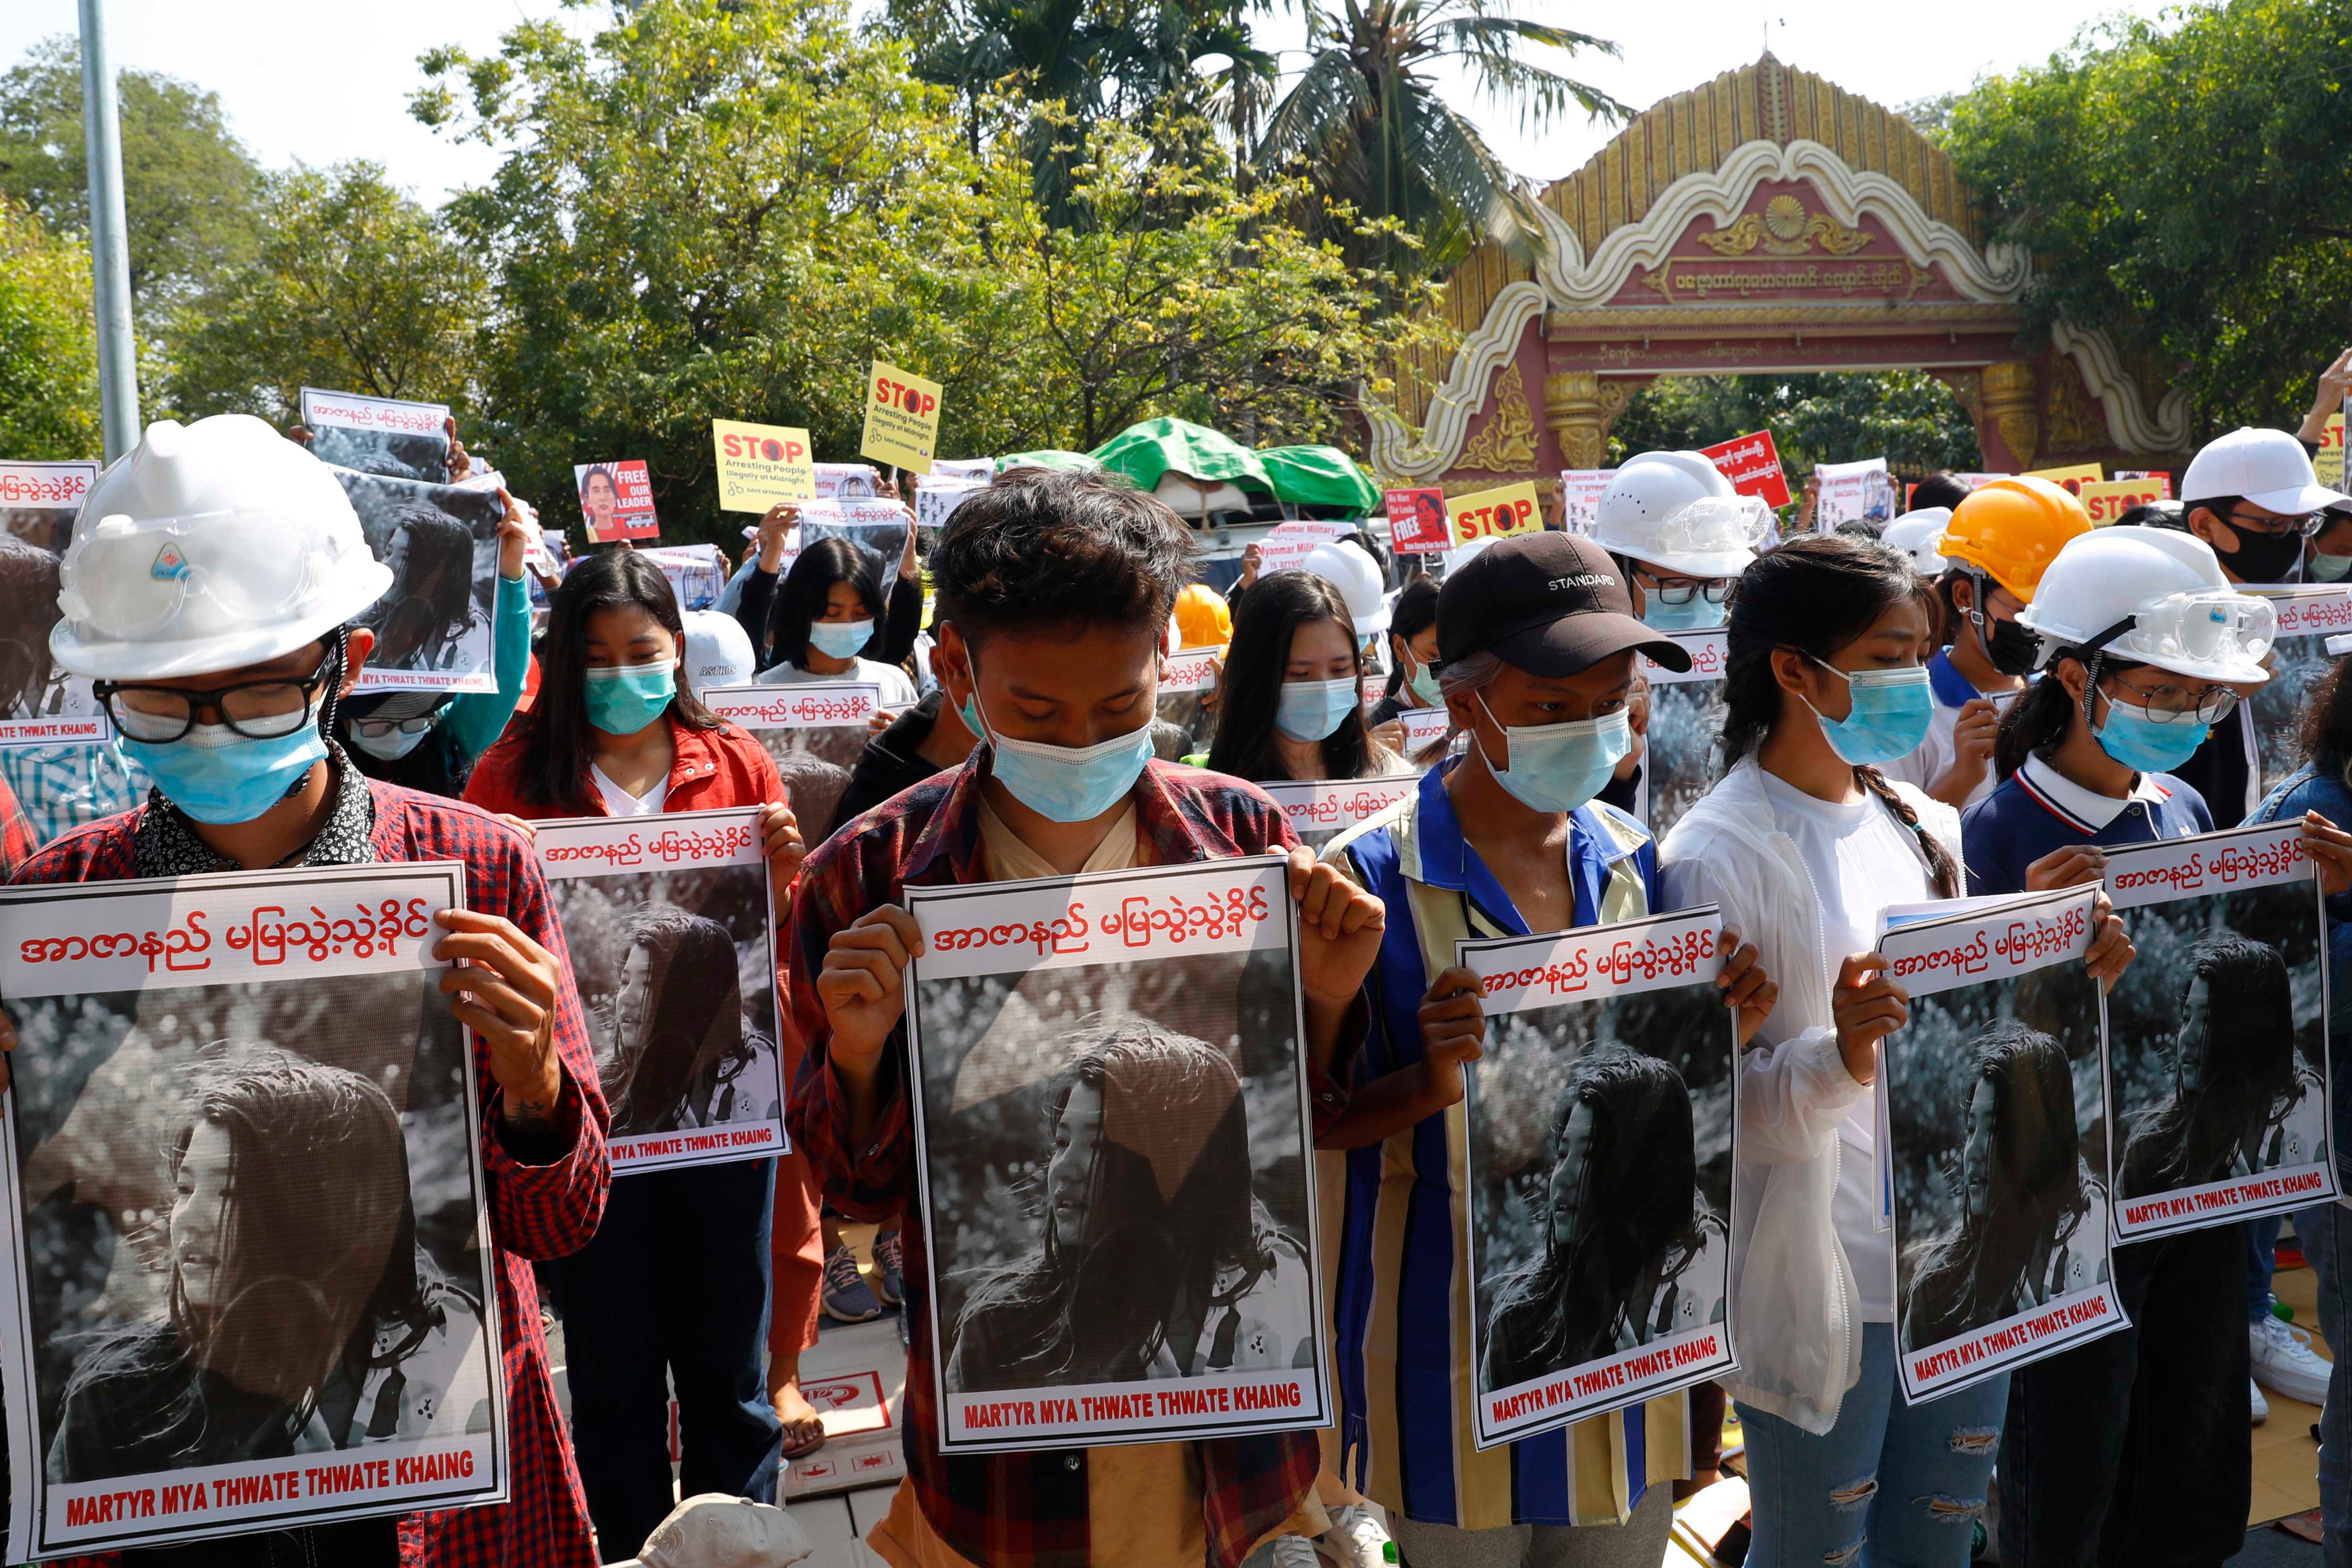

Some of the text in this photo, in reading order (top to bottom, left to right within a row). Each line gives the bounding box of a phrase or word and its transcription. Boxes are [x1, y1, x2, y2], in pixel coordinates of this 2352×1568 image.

[876, 378, 935, 417] STOP
[313, 405, 373, 425] အာဇာနည်
[872, 415, 895, 431] Illegally
[873, 405, 932, 431] Arresting People
[723, 433, 803, 464] STOP
[617, 470, 647, 484] FREE
[725, 459, 771, 472] Arresting
[774, 464, 806, 475] People
[726, 470, 759, 480] Illegally
[617, 496, 652, 509] LEADER
[629, 485, 649, 496] OUR
[1393, 515, 1422, 542] FREE
[1458, 499, 1532, 539] STOP
[1548, 574, 1615, 591] STANDARD
[362, 674, 380, 685] MYA
[382, 674, 415, 685] THWATE
[418, 675, 450, 685] THWATE
[453, 676, 483, 686] KHAING
[700, 664, 736, 676] ASTROS
[715, 695, 870, 722] အာဇာနည် မမြသွဲ့သွဲ့ခိုင်
[20, 725, 56, 735] THWATE
[62, 724, 96, 733] KHAING
[546, 825, 752, 866] အာဇာနည် မမြသွဲ့သွဲ့ခိုင်
[2116, 838, 2304, 889] အာဇာနည် မမြသွဲ့သွဲ့ခိုင်
[21, 898, 428, 973] အာဇာနည် မမြသွဲ့သွဲ့ခိုင်
[934, 886, 1269, 956] အာဇာနည် မမြသွဲ့သွဲ့ခိုင်
[1894, 908, 2083, 976] အာဇာနည် မမြသွဲ့သွဲ့ခိုင်
[1481, 929, 1714, 997] အာဇာနည် မမြသွဲ့သွဲ့ခိုင်
[612, 1145, 635, 1160] MYA
[638, 1139, 681, 1155] THWATE
[685, 1134, 728, 1150] THWATE
[732, 1129, 772, 1145] KHAING
[2127, 1173, 2321, 1223] MARTYR MYA THWATE THWATE KHAING
[1915, 1296, 2106, 1380] MARTYR MYA THWATE THWATE KHAING
[1494, 1336, 1717, 1422] MARTYR MYA THWATE THWATE KHAING
[965, 1383, 1300, 1428] MARTYR MYA THWATE THWATE KHAING
[68, 1450, 473, 1526] MARTYR MYA THWATE THWATE KHAING
